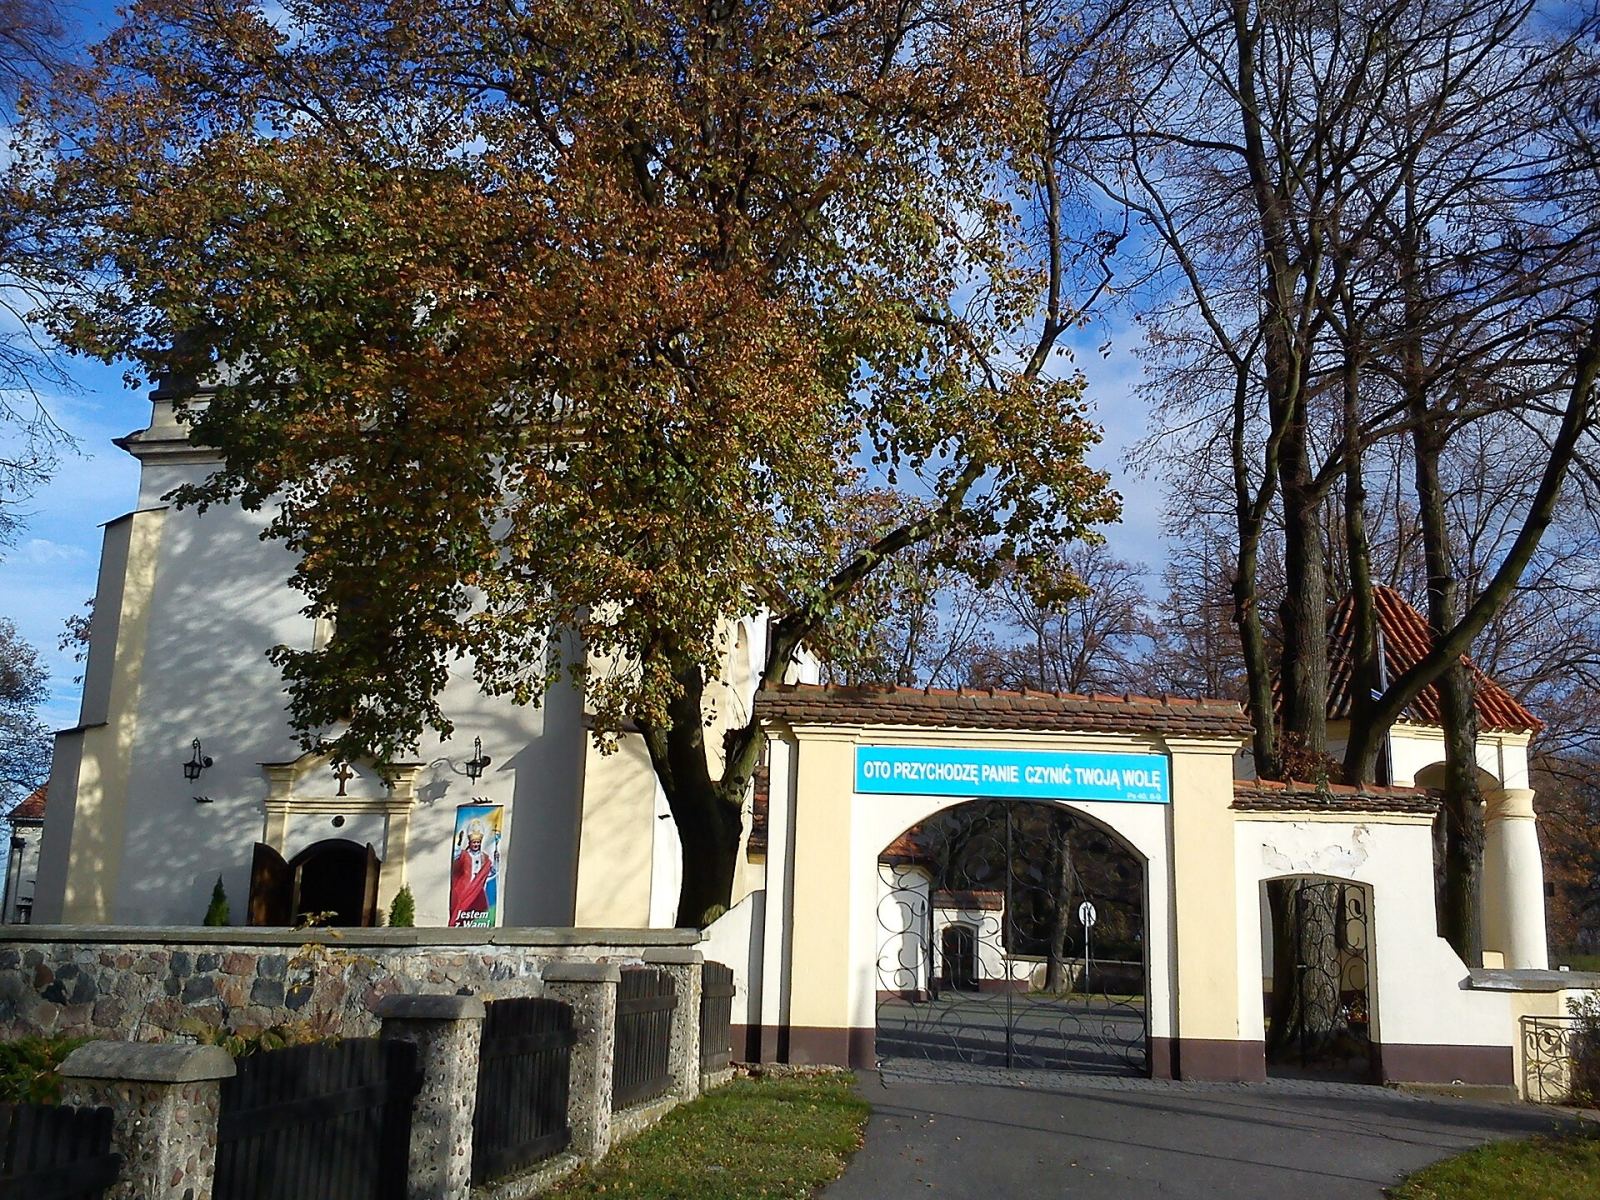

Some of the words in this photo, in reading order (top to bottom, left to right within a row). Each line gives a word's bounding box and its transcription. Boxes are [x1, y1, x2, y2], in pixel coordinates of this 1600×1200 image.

[863, 760, 891, 779] OTO
[894, 761, 980, 785] PRZYCHODZĘ
[982, 764, 1019, 783] PANIE
[1025, 763, 1072, 785] CZYNIĆ
[1074, 767, 1121, 790] TWOJĄ
[1122, 769, 1161, 791] WOLĘ
[456, 909, 489, 921] Jestem
[463, 919, 491, 928] Wami
